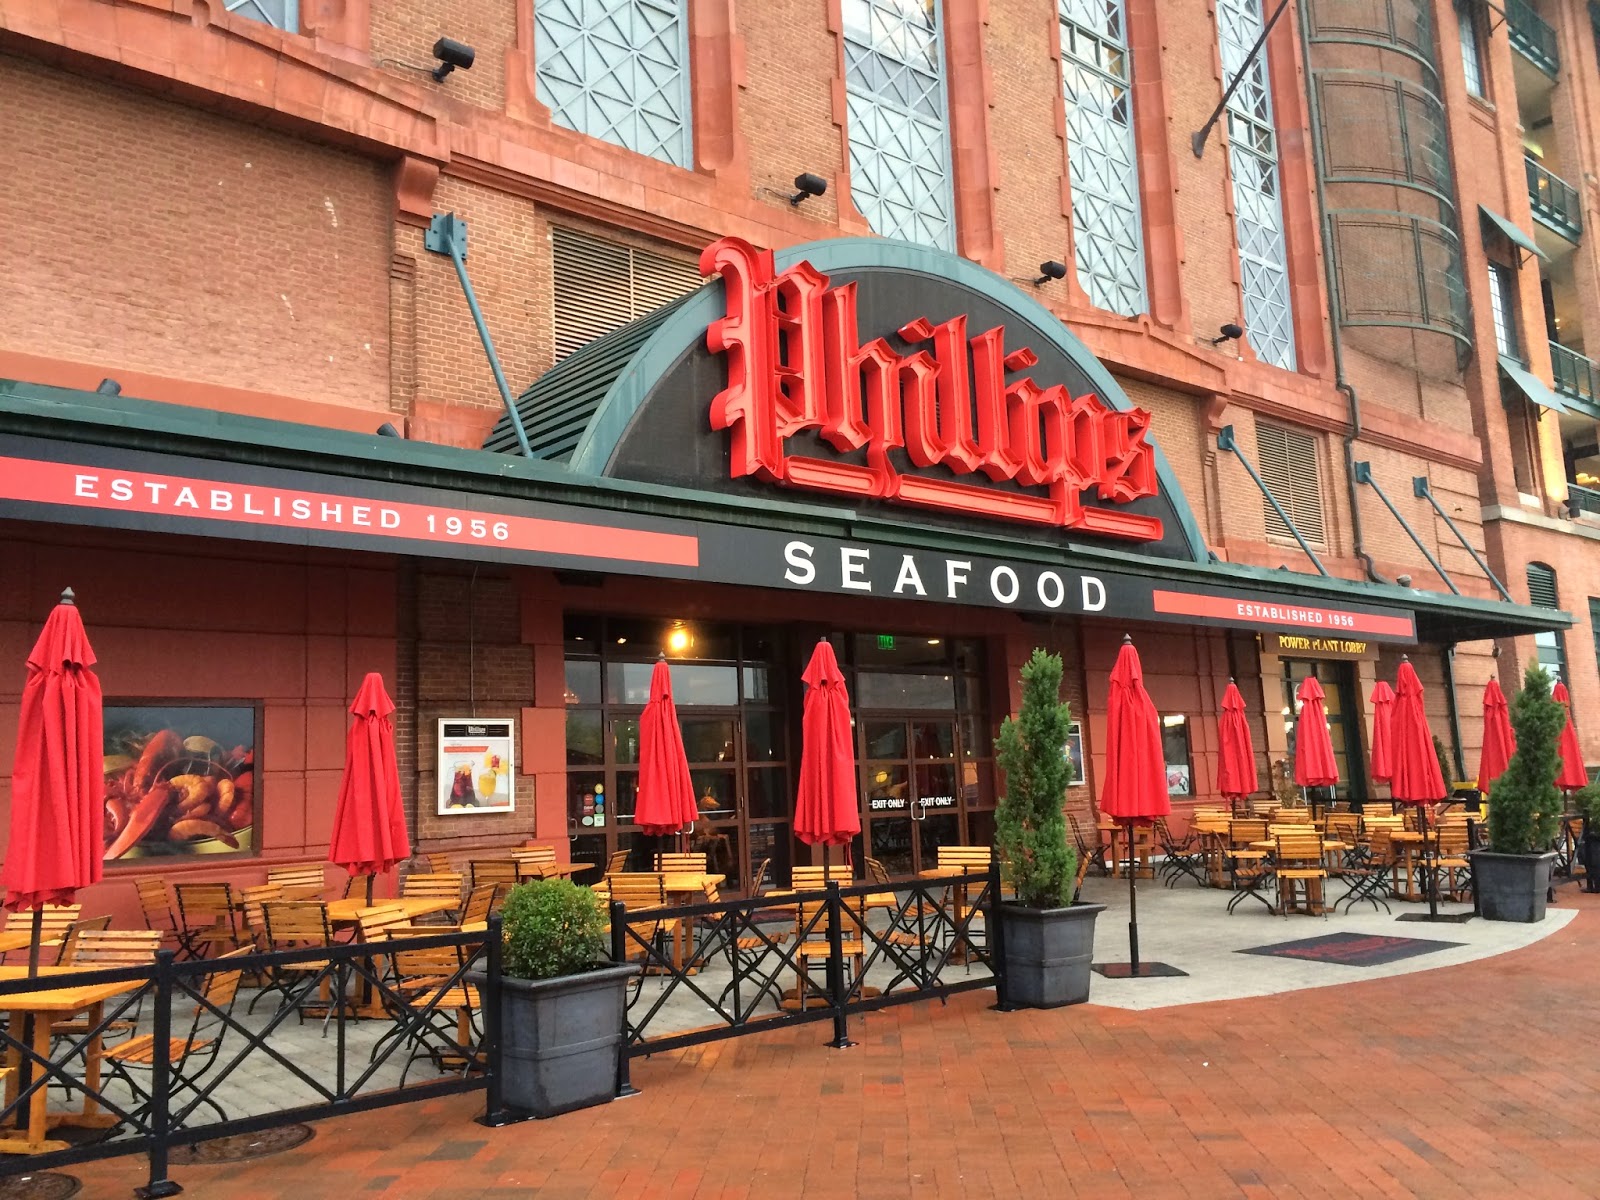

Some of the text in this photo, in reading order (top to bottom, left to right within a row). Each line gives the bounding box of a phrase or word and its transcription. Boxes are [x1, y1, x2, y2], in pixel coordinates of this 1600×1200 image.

[699, 236, 1160, 529] Phillips
[74, 474, 510, 542] ESTABLISHED 1956
[783, 541, 1107, 612] SEAFOOD
[1237, 603, 1354, 627] ESTABLISHED 1956
[1279, 635, 1367, 654] POWER PLANT LOBBY
[872, 799, 905, 809] EXIT ONLY
[920, 796, 952, 807] EXIT ONLY
